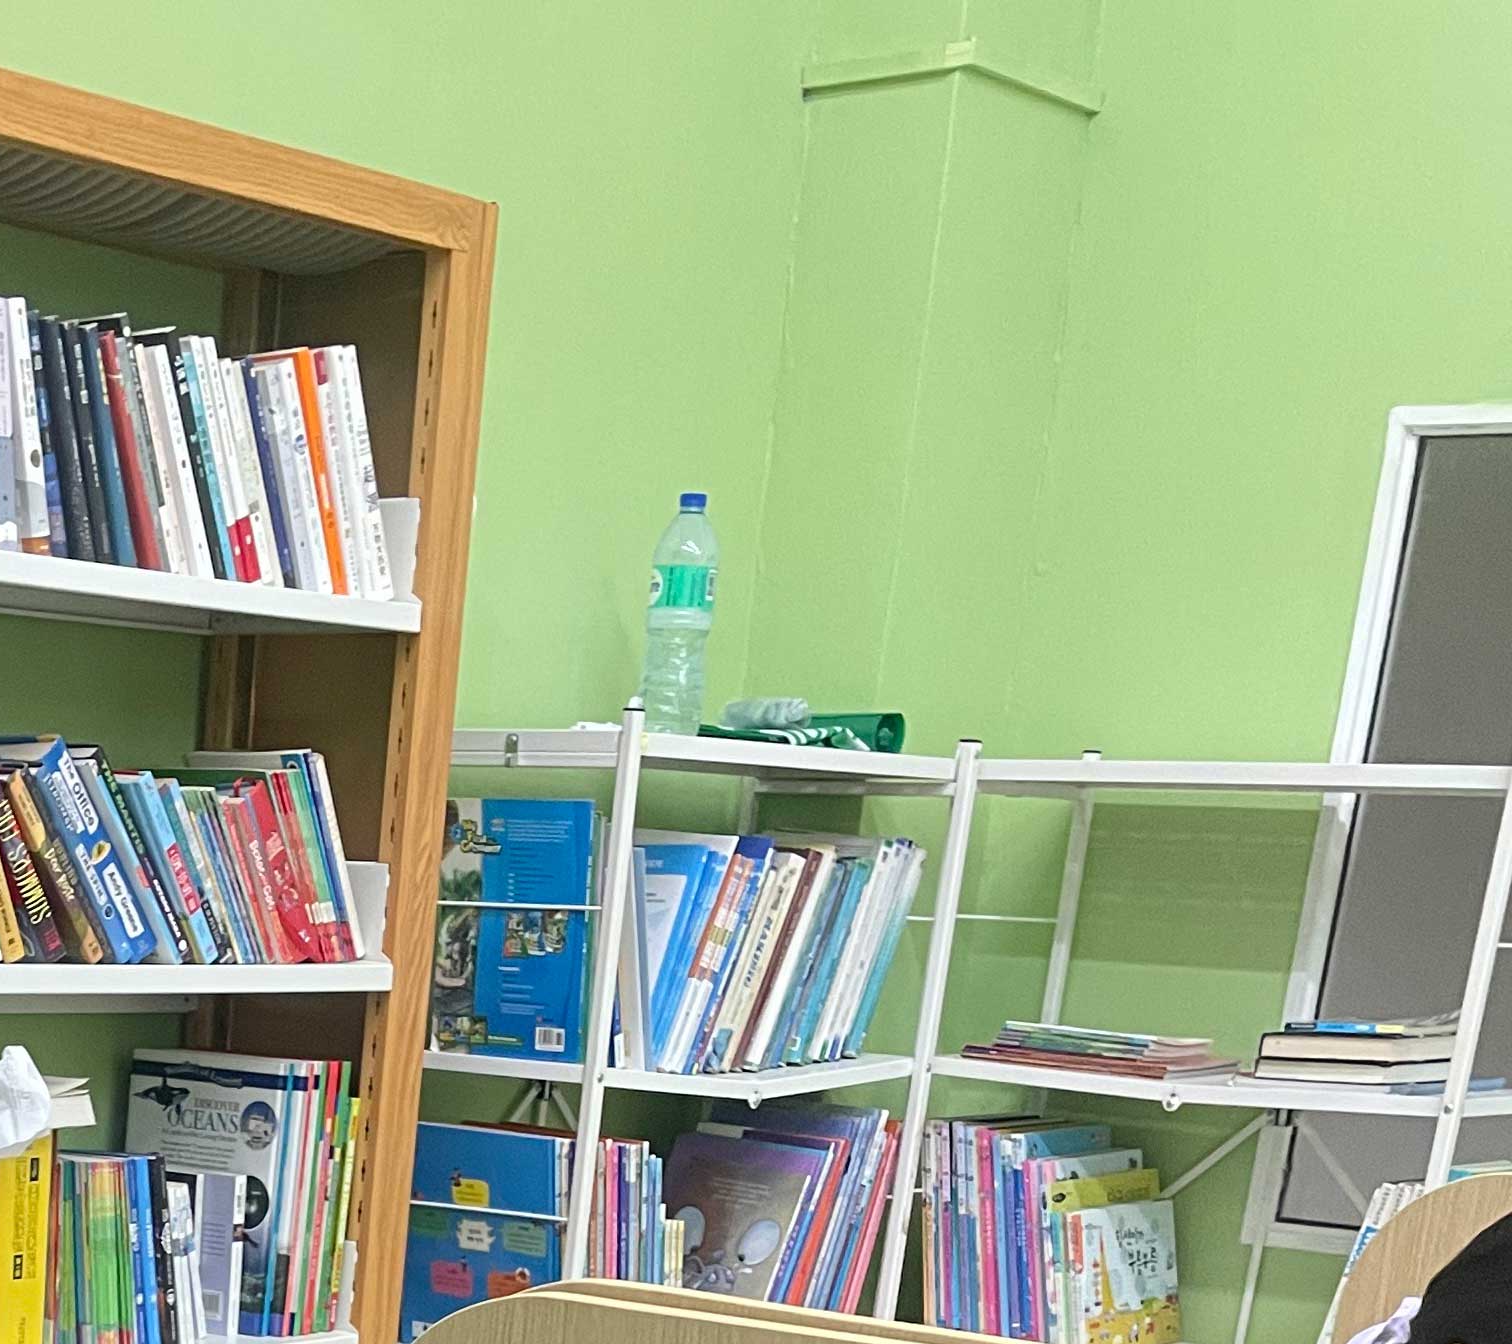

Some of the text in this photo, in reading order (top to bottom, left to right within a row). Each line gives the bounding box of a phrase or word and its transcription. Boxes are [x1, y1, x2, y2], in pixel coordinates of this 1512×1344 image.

[63, 758, 97, 827] The Office
[99, 759, 145, 855] THE MANTIS
[106, 869, 140, 933] Andy Greene
[167, 1108, 238, 1134] OCEANS
